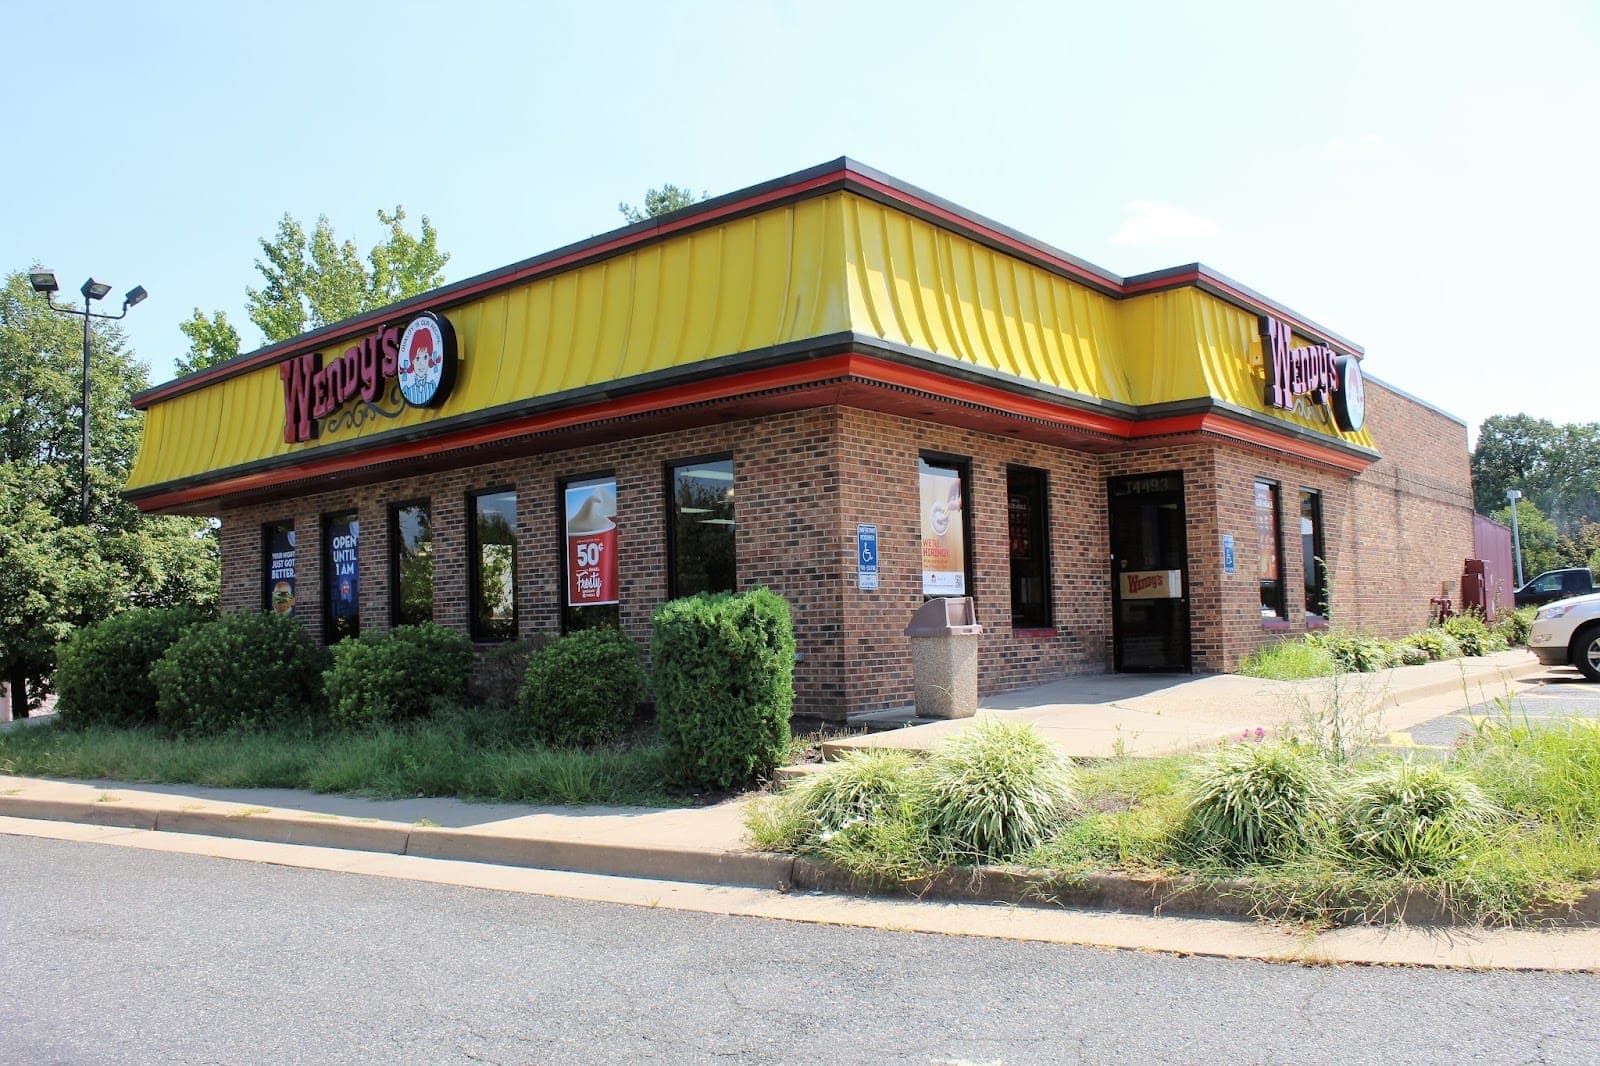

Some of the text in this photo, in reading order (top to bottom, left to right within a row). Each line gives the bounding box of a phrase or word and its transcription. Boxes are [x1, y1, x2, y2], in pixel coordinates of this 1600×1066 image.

[401, 327, 415, 352] QUALITY
[1268, 316, 1338, 411] Wendy's
[280, 324, 399, 443] Wendy's
[1127, 478, 1169, 494] 14493
[333, 536, 357, 549] OPEN
[333, 549, 357, 562] UNTIL
[577, 543, 604, 567] 50¢
[923, 548, 949, 557] HIRING!
[272, 558, 296, 568] JUST GOT
[336, 563, 354, 576] 1 AM
[272, 568, 296, 579] BETTER.
[576, 572, 603, 598] Frosty
[1128, 575, 1163, 593] Wendy's
